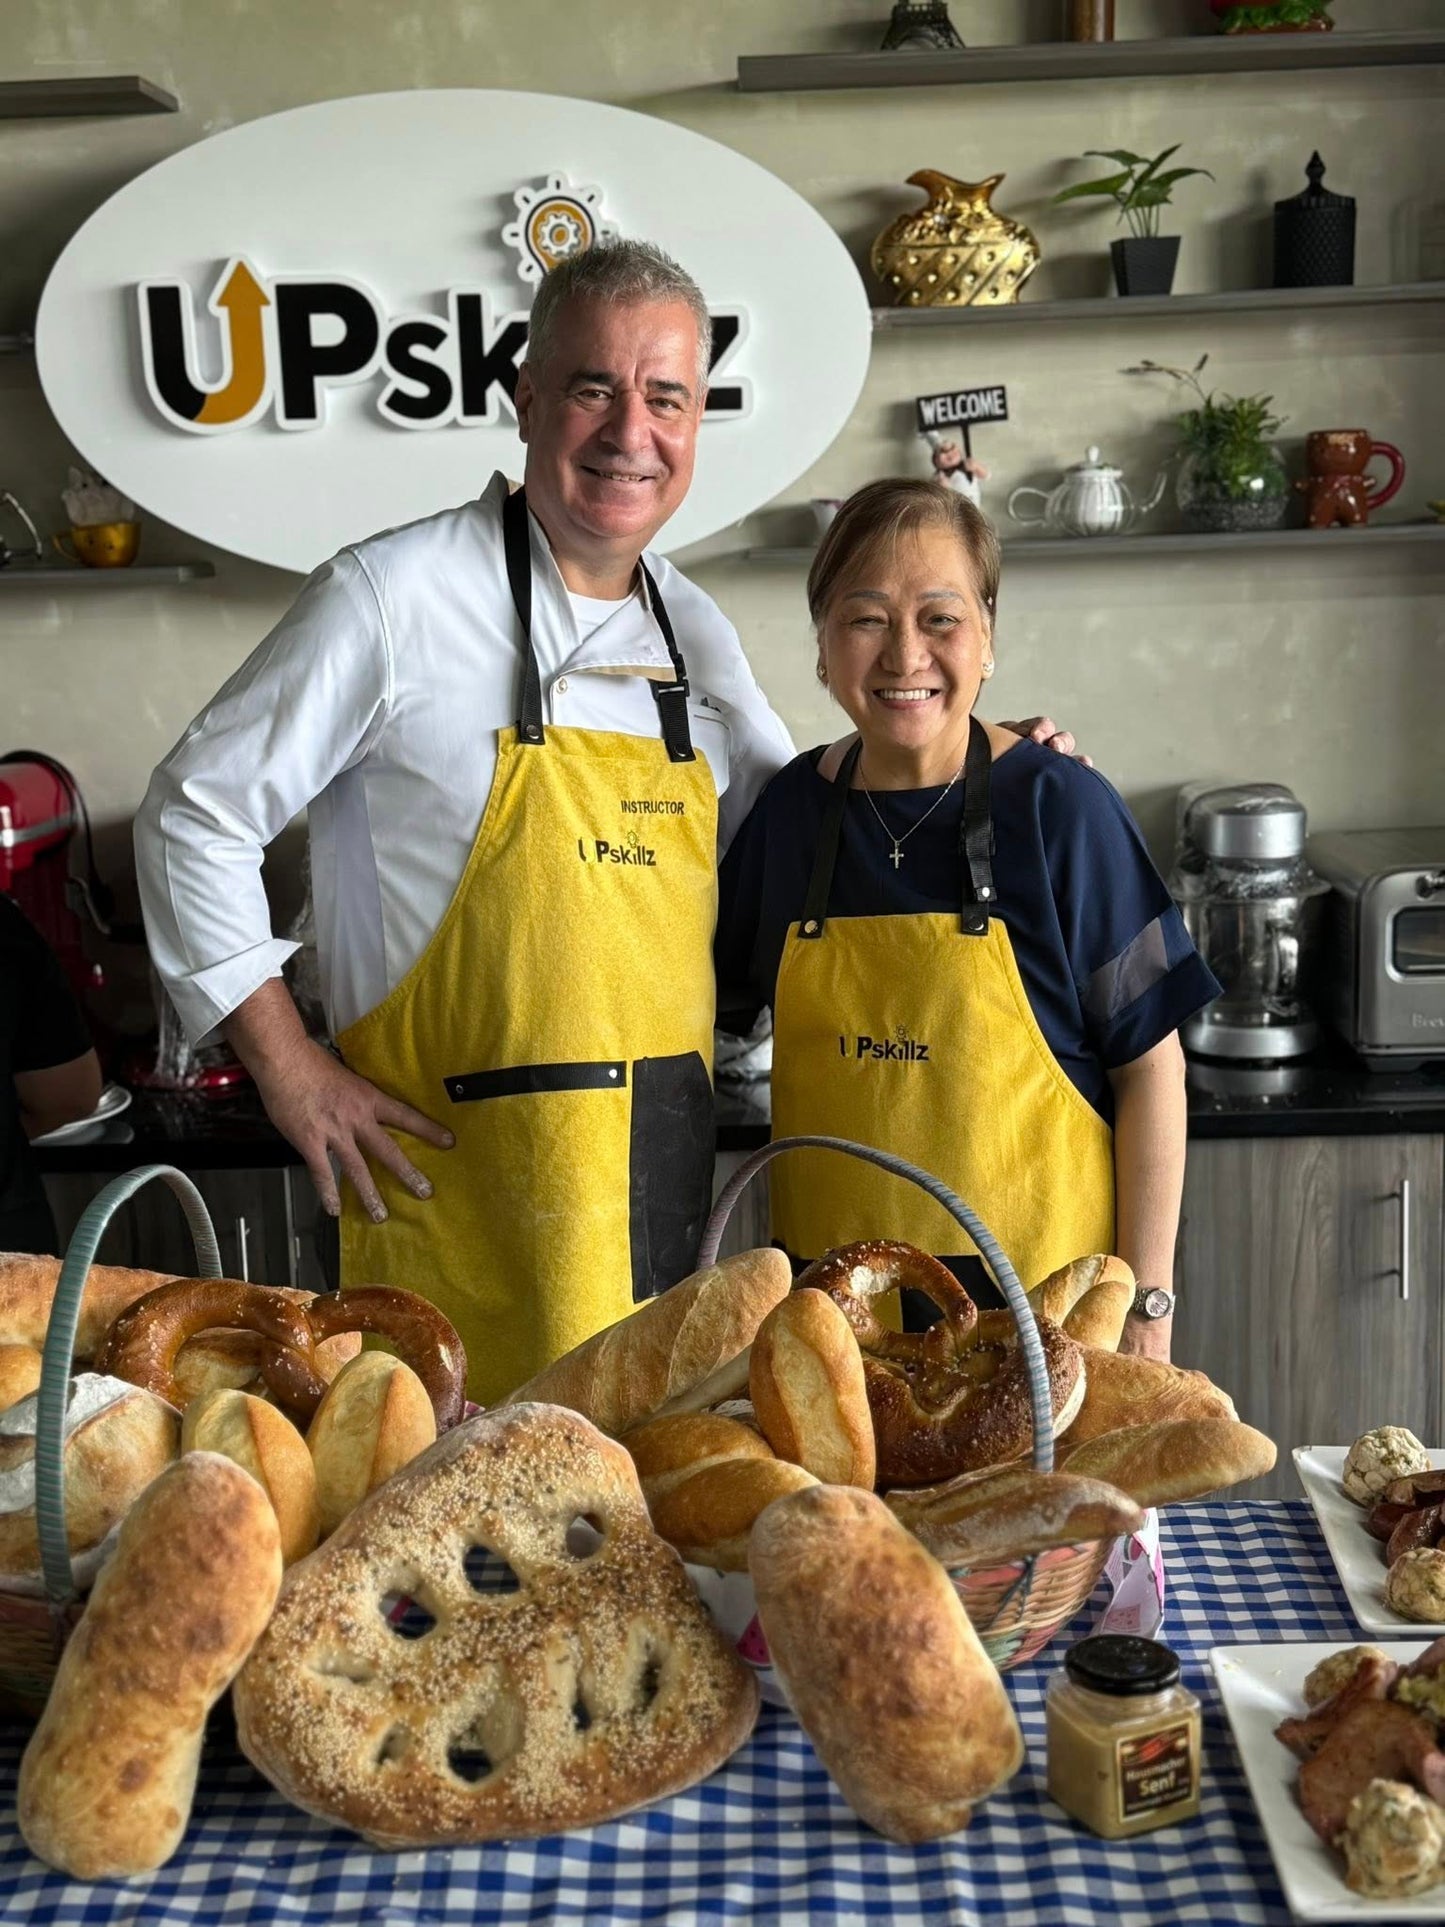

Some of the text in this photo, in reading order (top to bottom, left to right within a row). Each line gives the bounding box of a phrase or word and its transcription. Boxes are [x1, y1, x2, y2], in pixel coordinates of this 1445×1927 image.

[920, 389, 1005, 425] WELCOME
[621, 800, 684, 815] INSTRUCTOR
[1139, 1771, 1176, 1797] Senf
